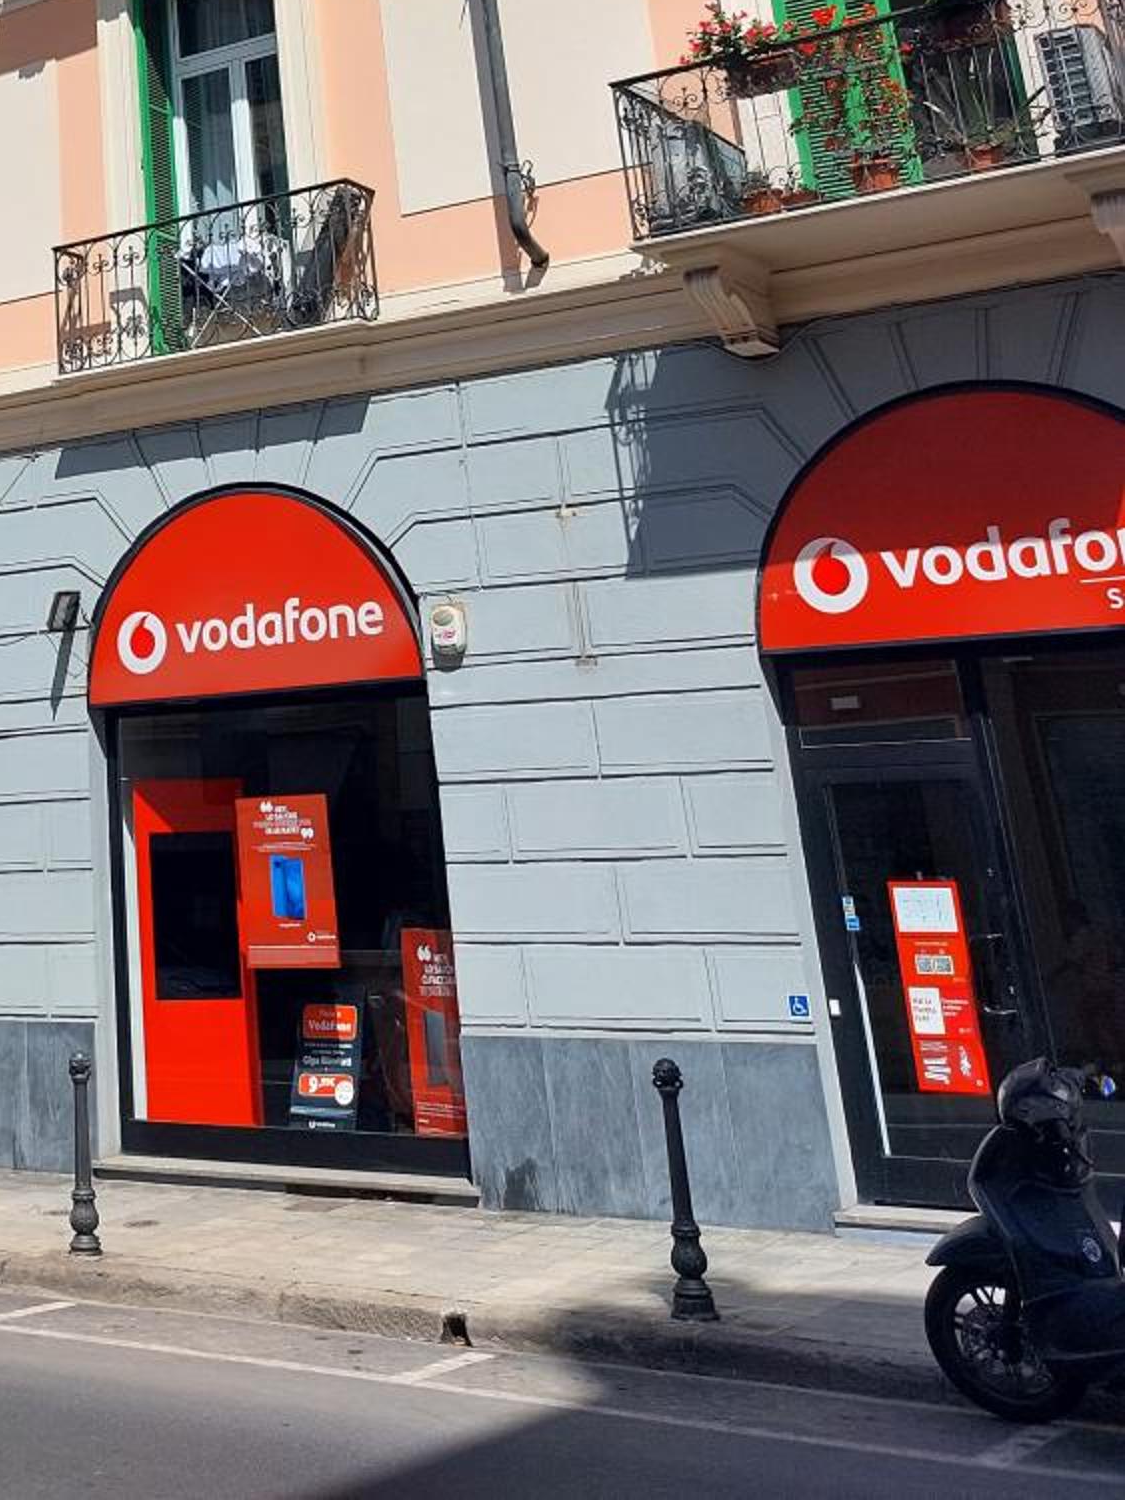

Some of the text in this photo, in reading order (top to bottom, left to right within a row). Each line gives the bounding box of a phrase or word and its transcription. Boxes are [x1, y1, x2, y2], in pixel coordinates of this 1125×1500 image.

[880, 517, 1125, 589] vodafo
[176, 598, 384, 653] vodafone
[1105, 586, 1125, 610] S
